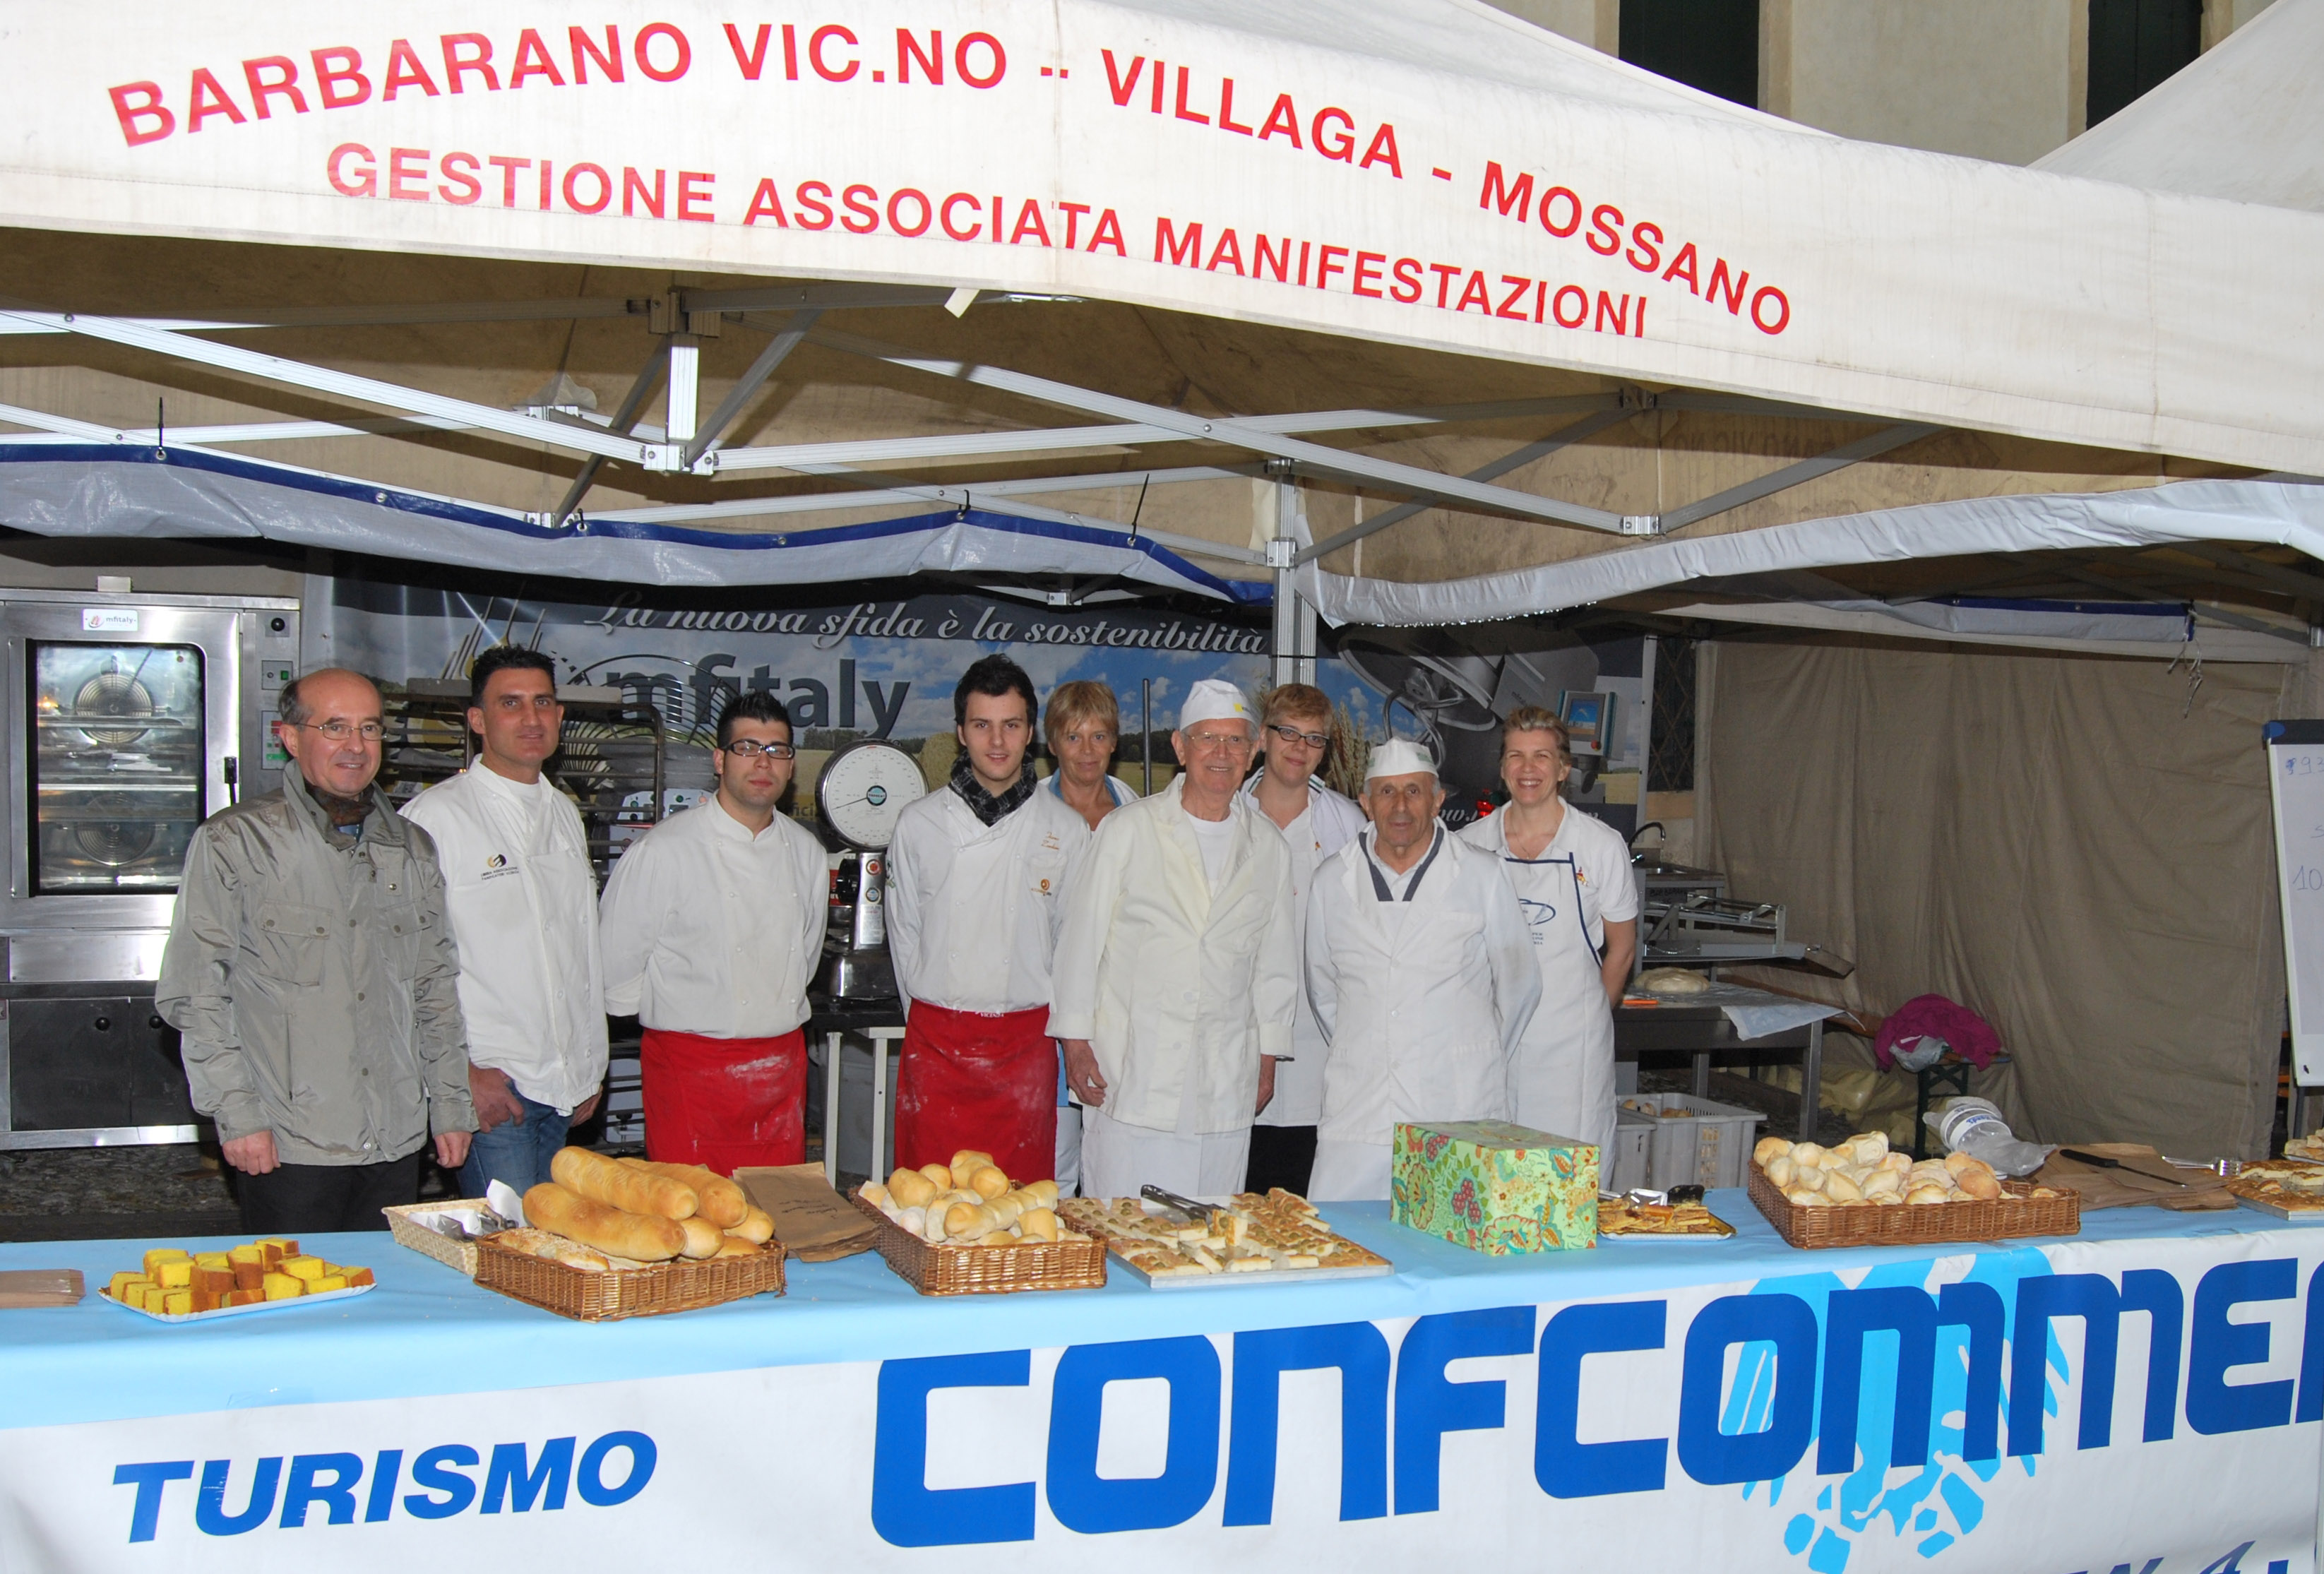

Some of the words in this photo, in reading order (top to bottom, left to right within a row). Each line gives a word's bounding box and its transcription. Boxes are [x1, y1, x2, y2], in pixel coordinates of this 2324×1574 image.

[108, 22, 692, 148] BARBARANO
[722, 23, 1007, 90] VIC.NO
[1100, 49, 1402, 179] VILLAGA
[1431, 166, 1453, 181] -
[1479, 160, 1791, 336] MOSSANO
[326, 143, 716, 222] GESTIONE
[744, 177, 1128, 258] ASSOCIATA
[1154, 216, 1647, 338] MANIFESTAZIONI
[584, 591, 662, 635] La
[666, 609, 812, 633] nuova
[813, 602, 927, 649] sfida
[938, 609, 965, 638] è
[972, 606, 1020, 641] la
[1024, 621, 1268, 653] sostenibilità
[112, 1429, 658, 1544] TURISMO
[871, 1258, 2324, 1549] CONFCOMME
